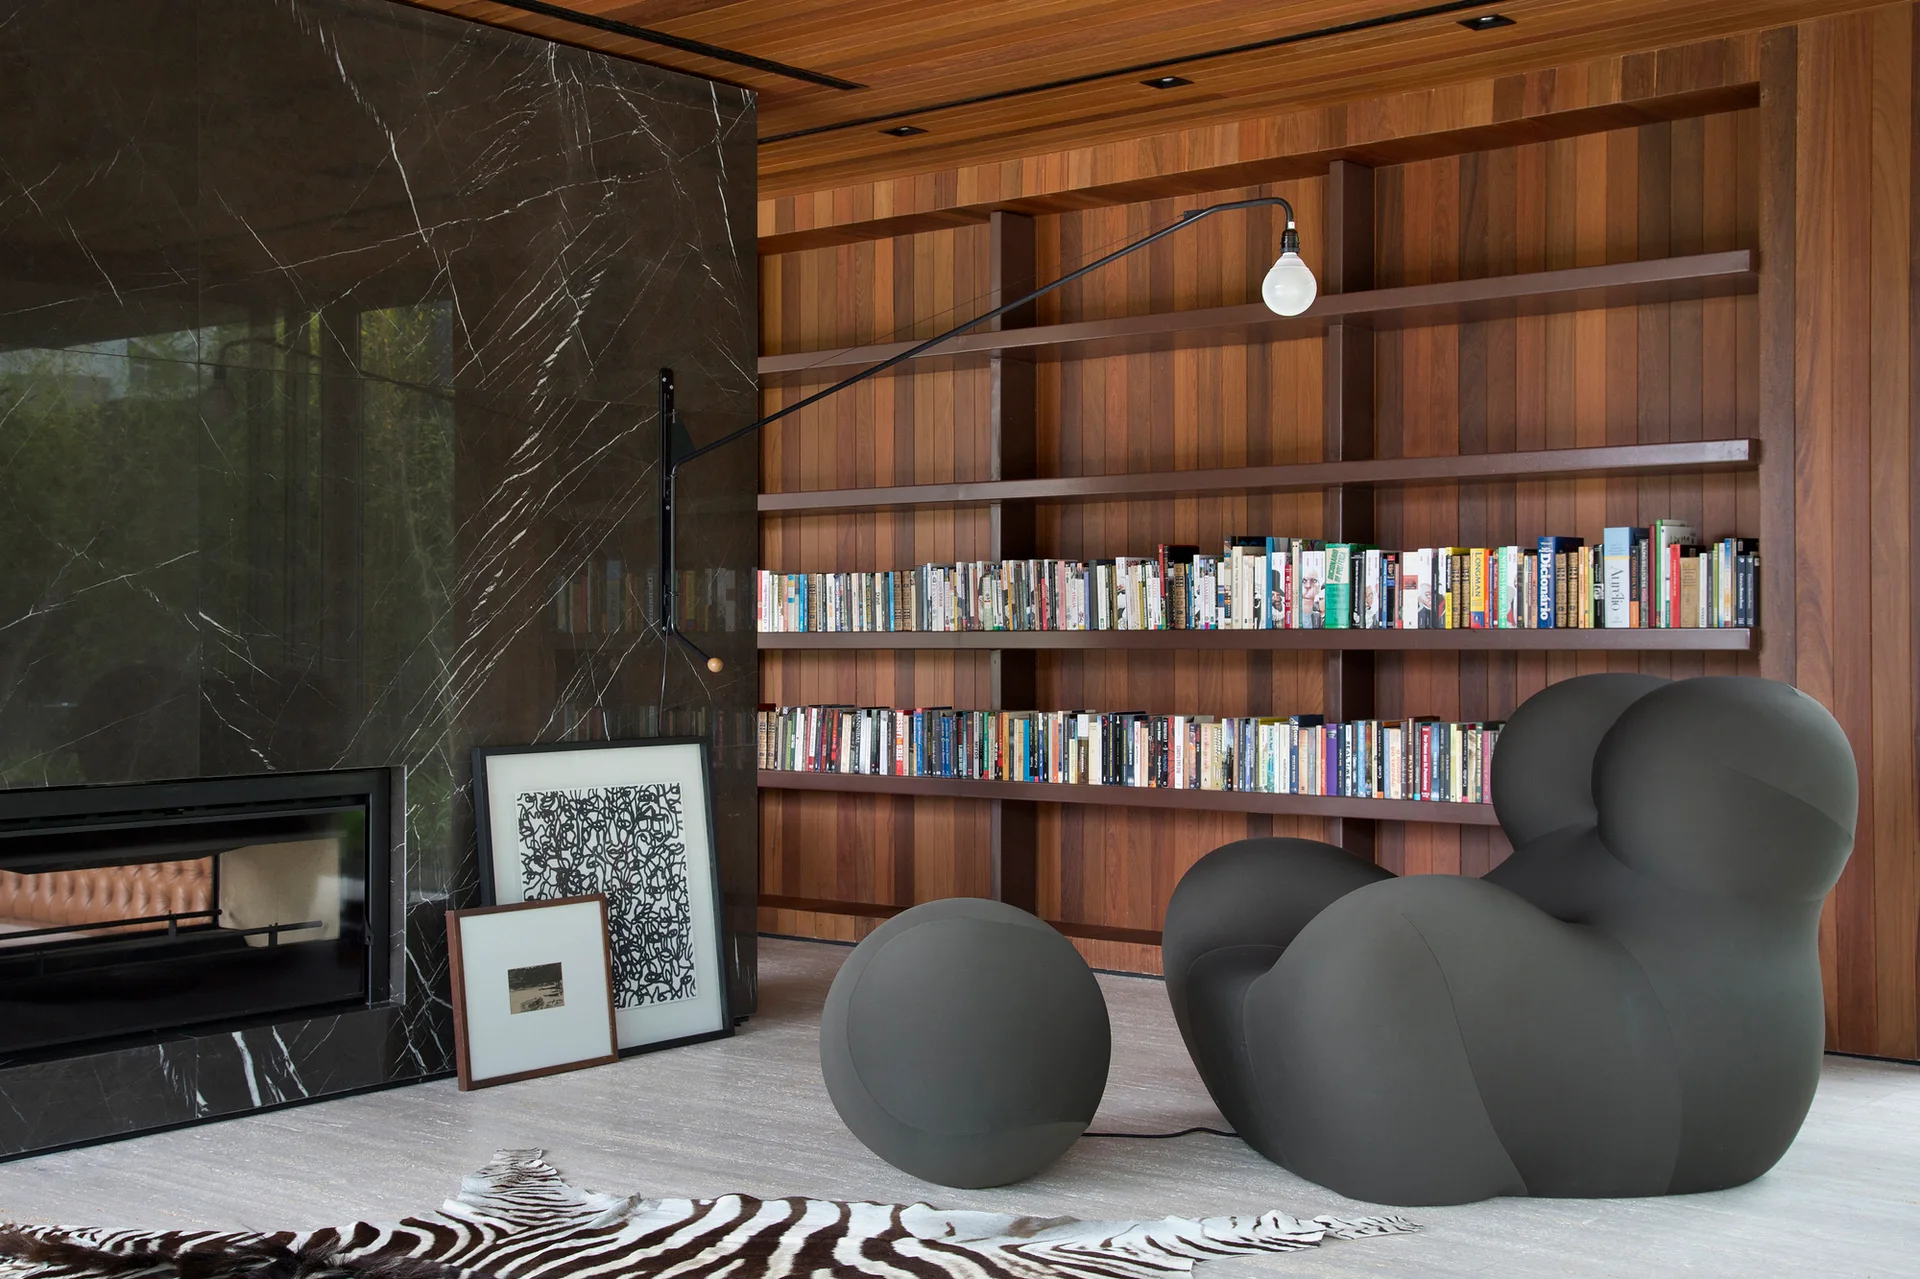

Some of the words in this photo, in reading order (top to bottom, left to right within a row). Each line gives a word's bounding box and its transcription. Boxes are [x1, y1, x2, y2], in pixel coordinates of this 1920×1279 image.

[1474, 552, 1482, 597] LONGMAN
[1540, 553, 1551, 620] Dicionário
[1610, 566, 1624, 611] Aurélio
